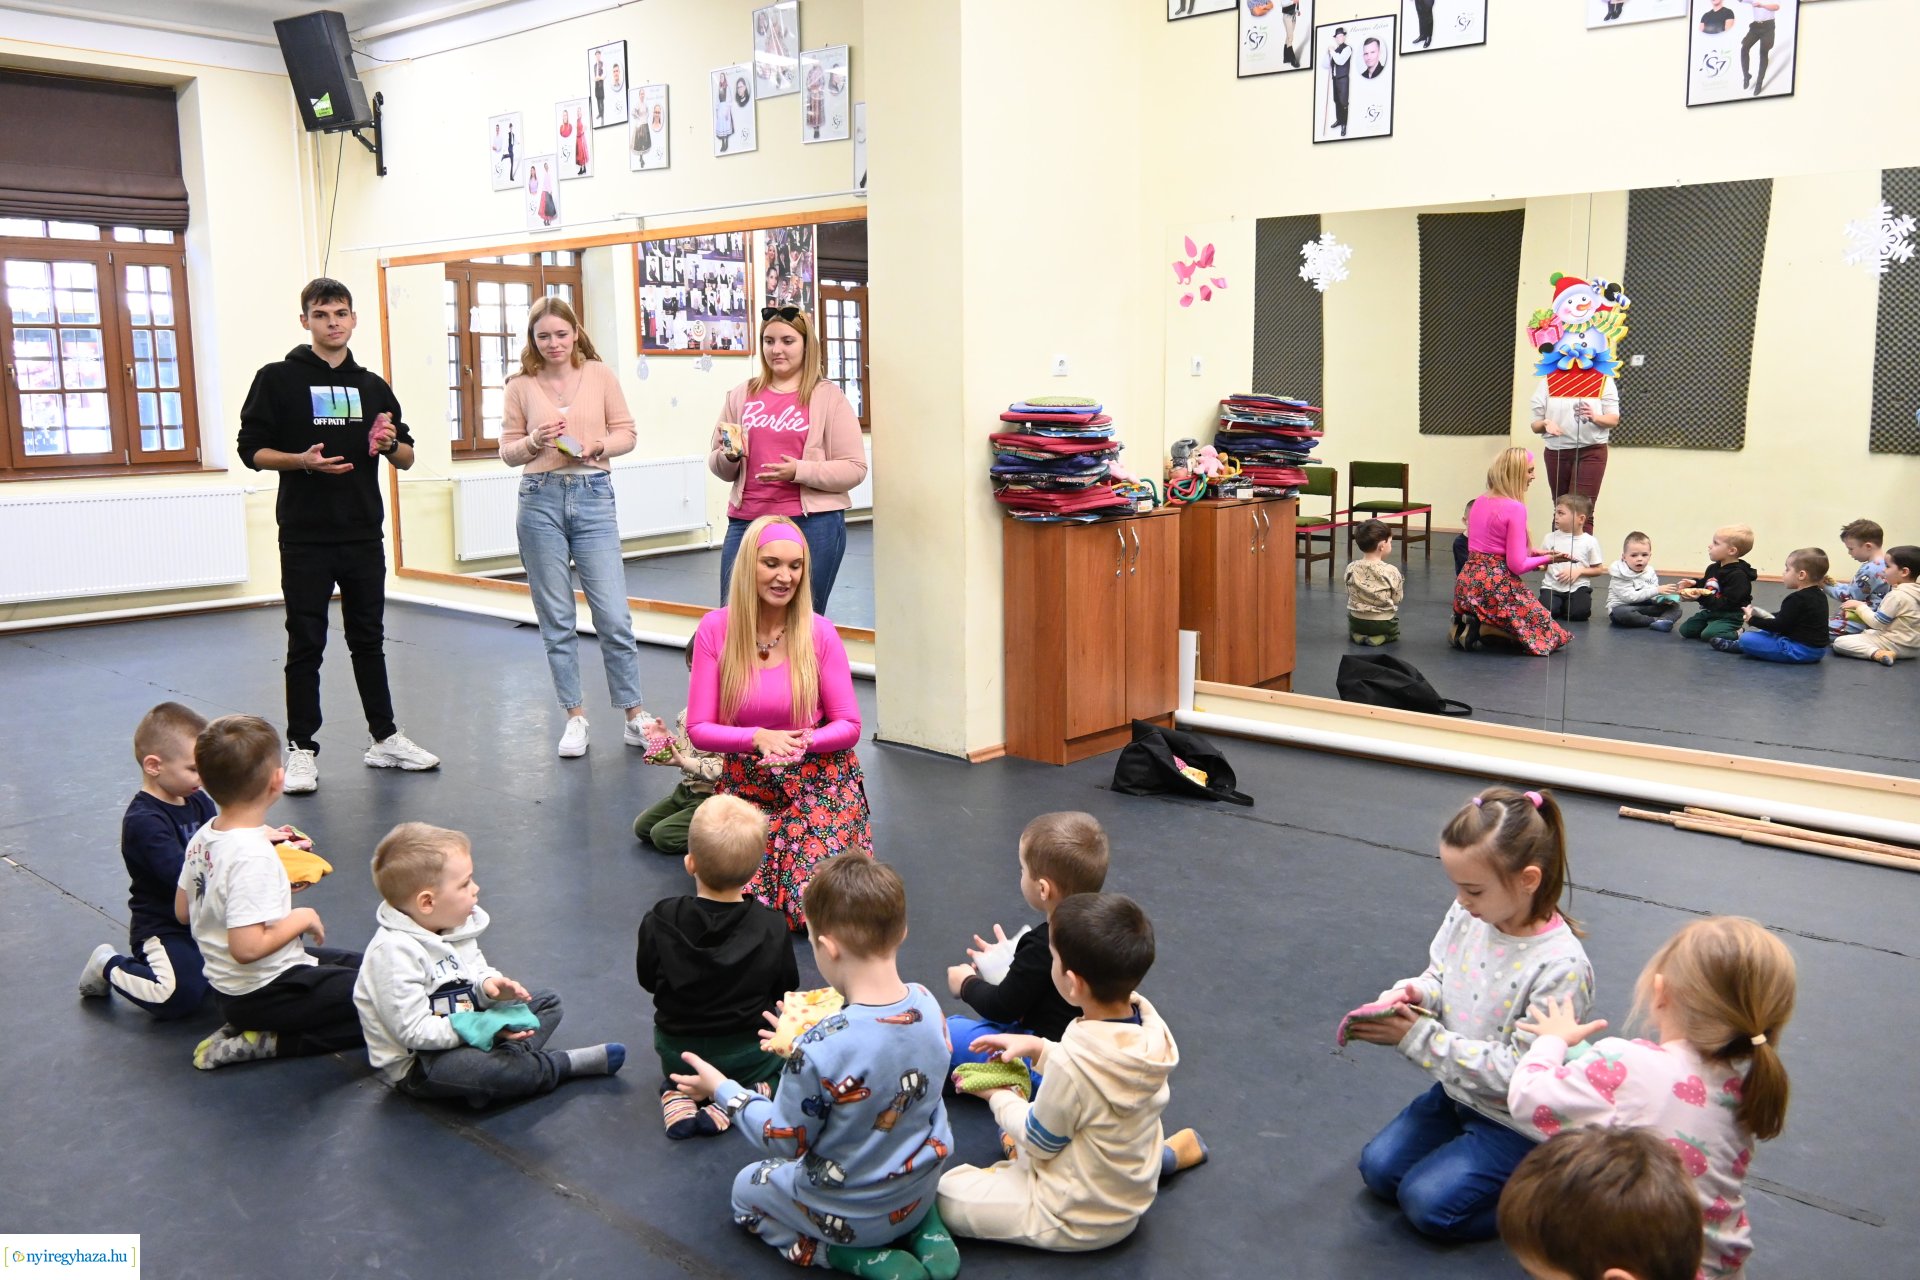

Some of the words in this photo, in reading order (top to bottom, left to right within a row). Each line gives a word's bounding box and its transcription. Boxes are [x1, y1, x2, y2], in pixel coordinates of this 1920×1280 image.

[313, 418, 327, 426] OFF
[328, 418, 346, 426] PATH
[742, 400, 810, 432] Barbie
